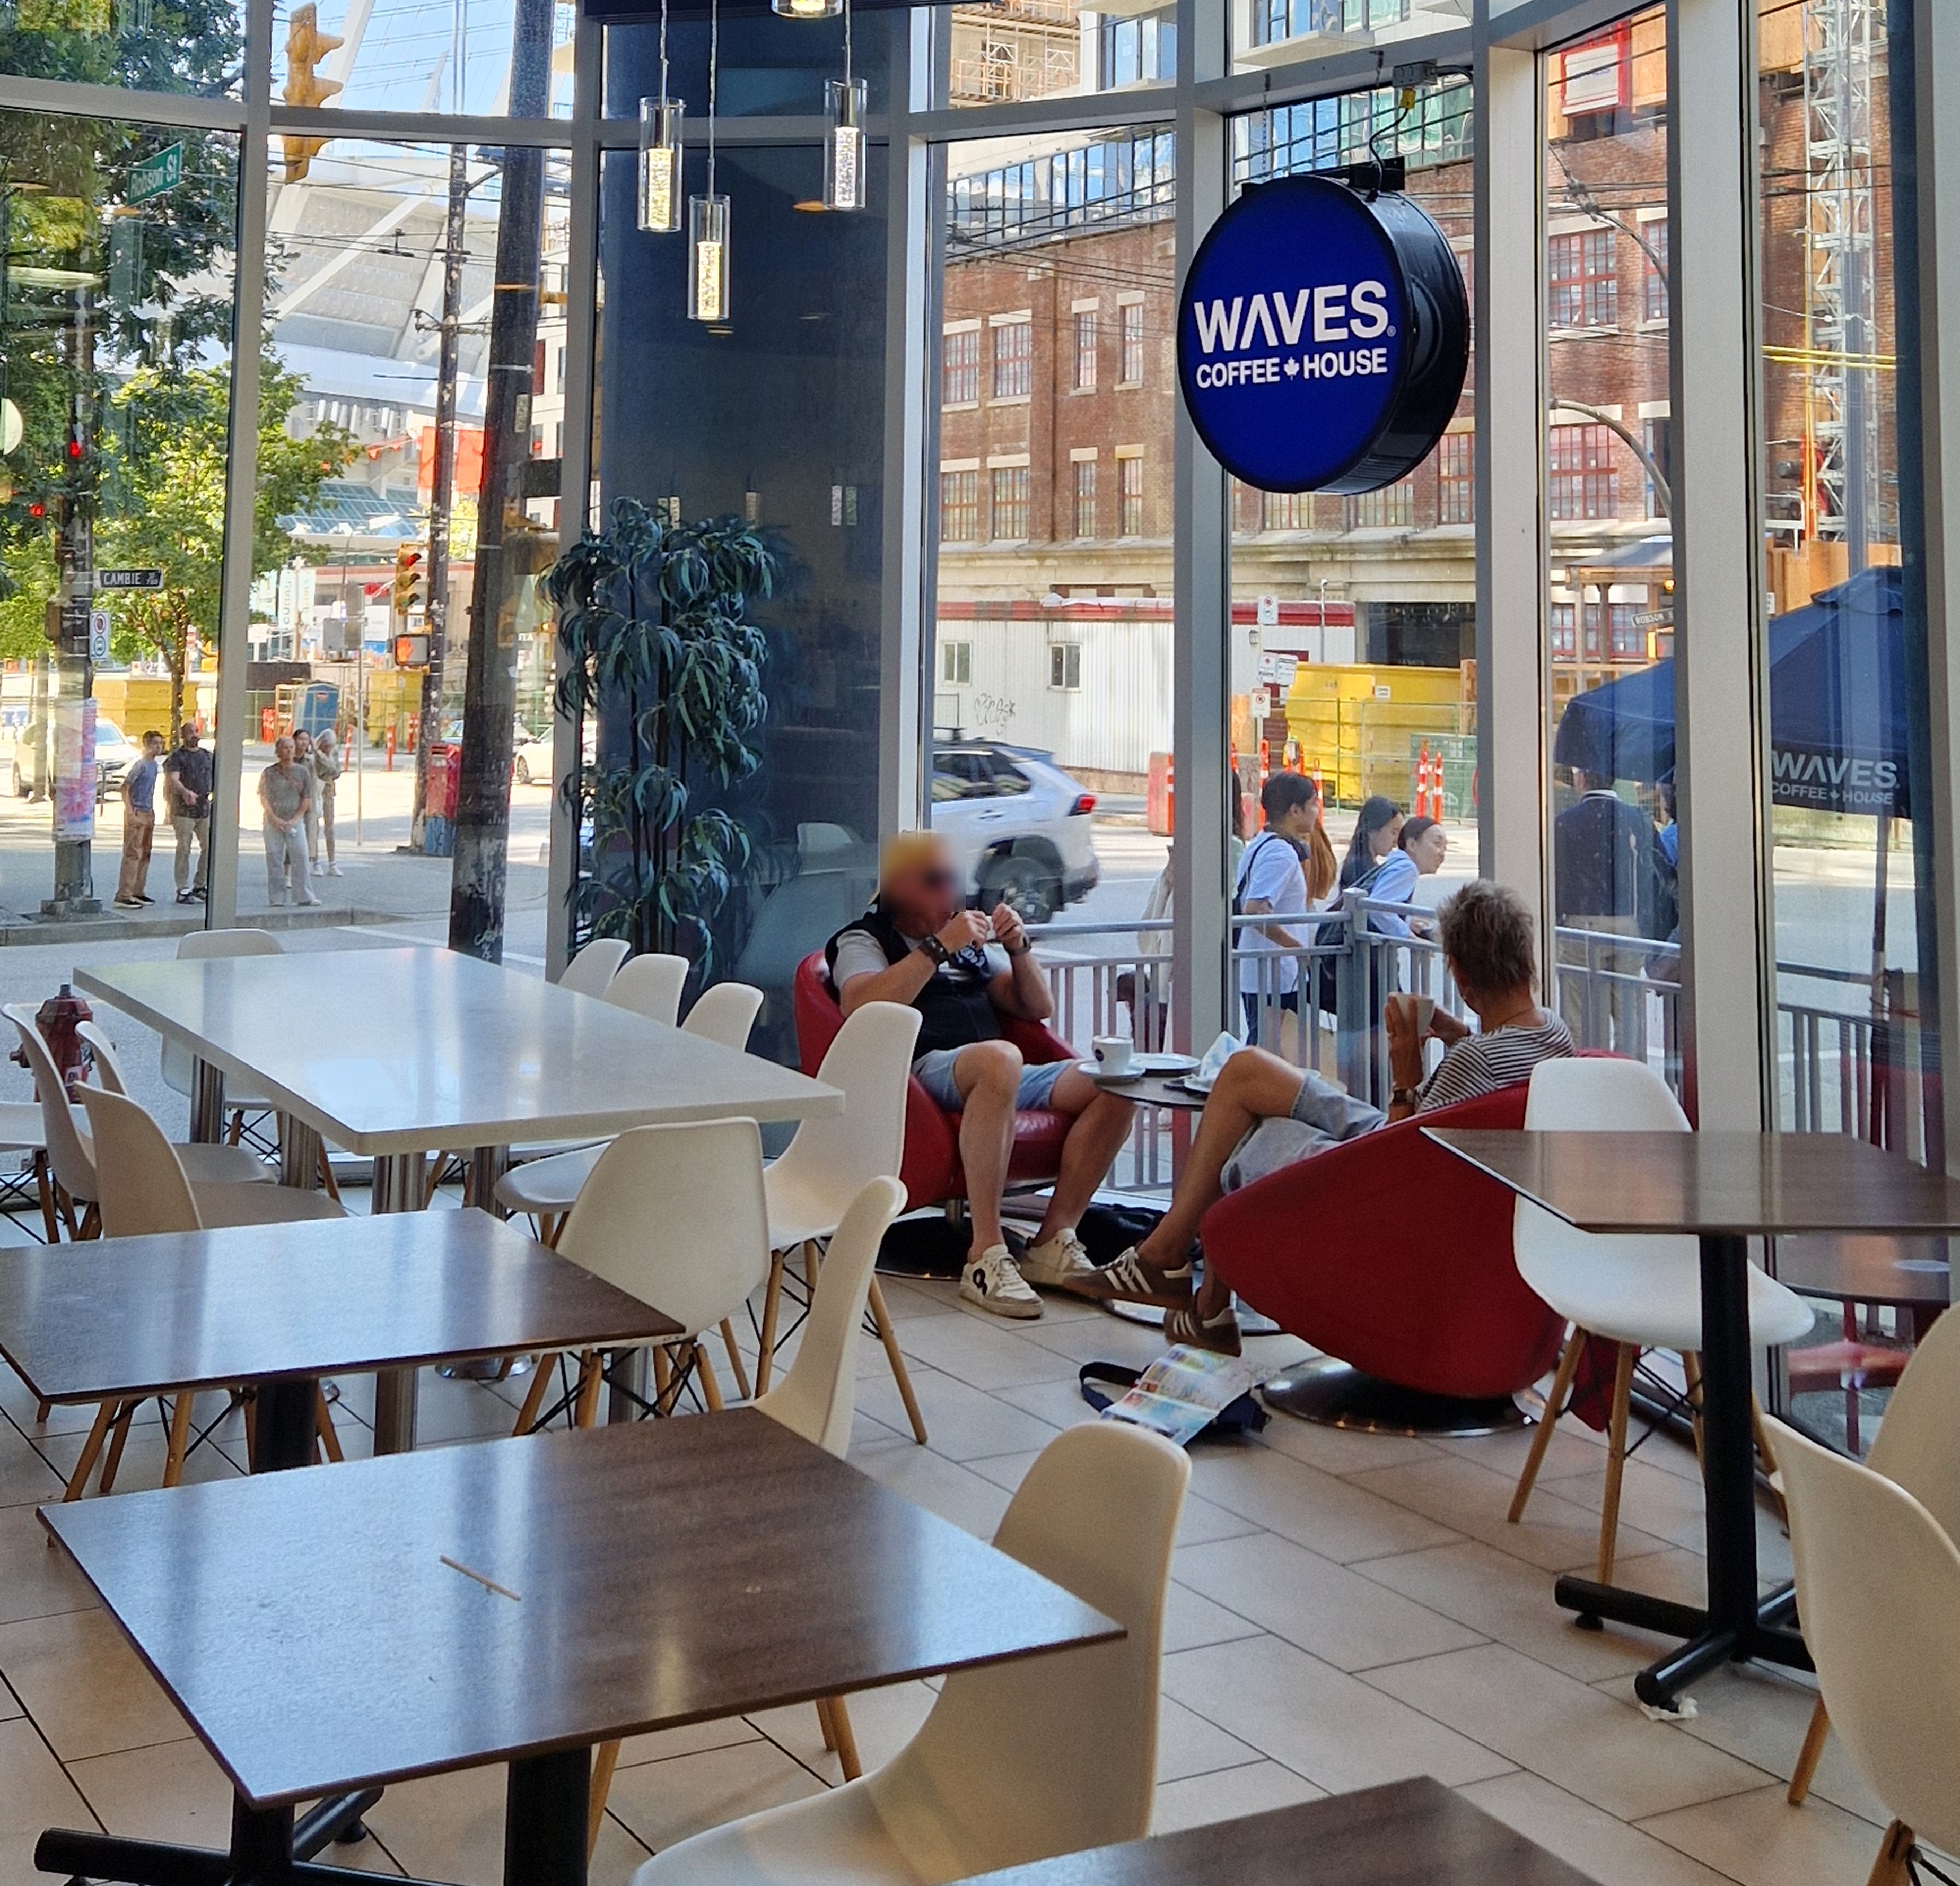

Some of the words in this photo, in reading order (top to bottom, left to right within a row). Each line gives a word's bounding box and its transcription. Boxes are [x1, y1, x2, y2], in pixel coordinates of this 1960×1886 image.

[130, 166, 163, 199] Robson
[166, 154, 177, 182] St
[1194, 280, 1389, 353] WAVES
[1196, 357, 1280, 389] COFFEE
[1303, 348, 1388, 379] HOUSE
[103, 573, 141, 585] CAMBIE
[1772, 750, 1897, 788] WAVES
[1772, 782, 1828, 800] COFFEE
[1843, 790, 1894, 805] HOUSE
